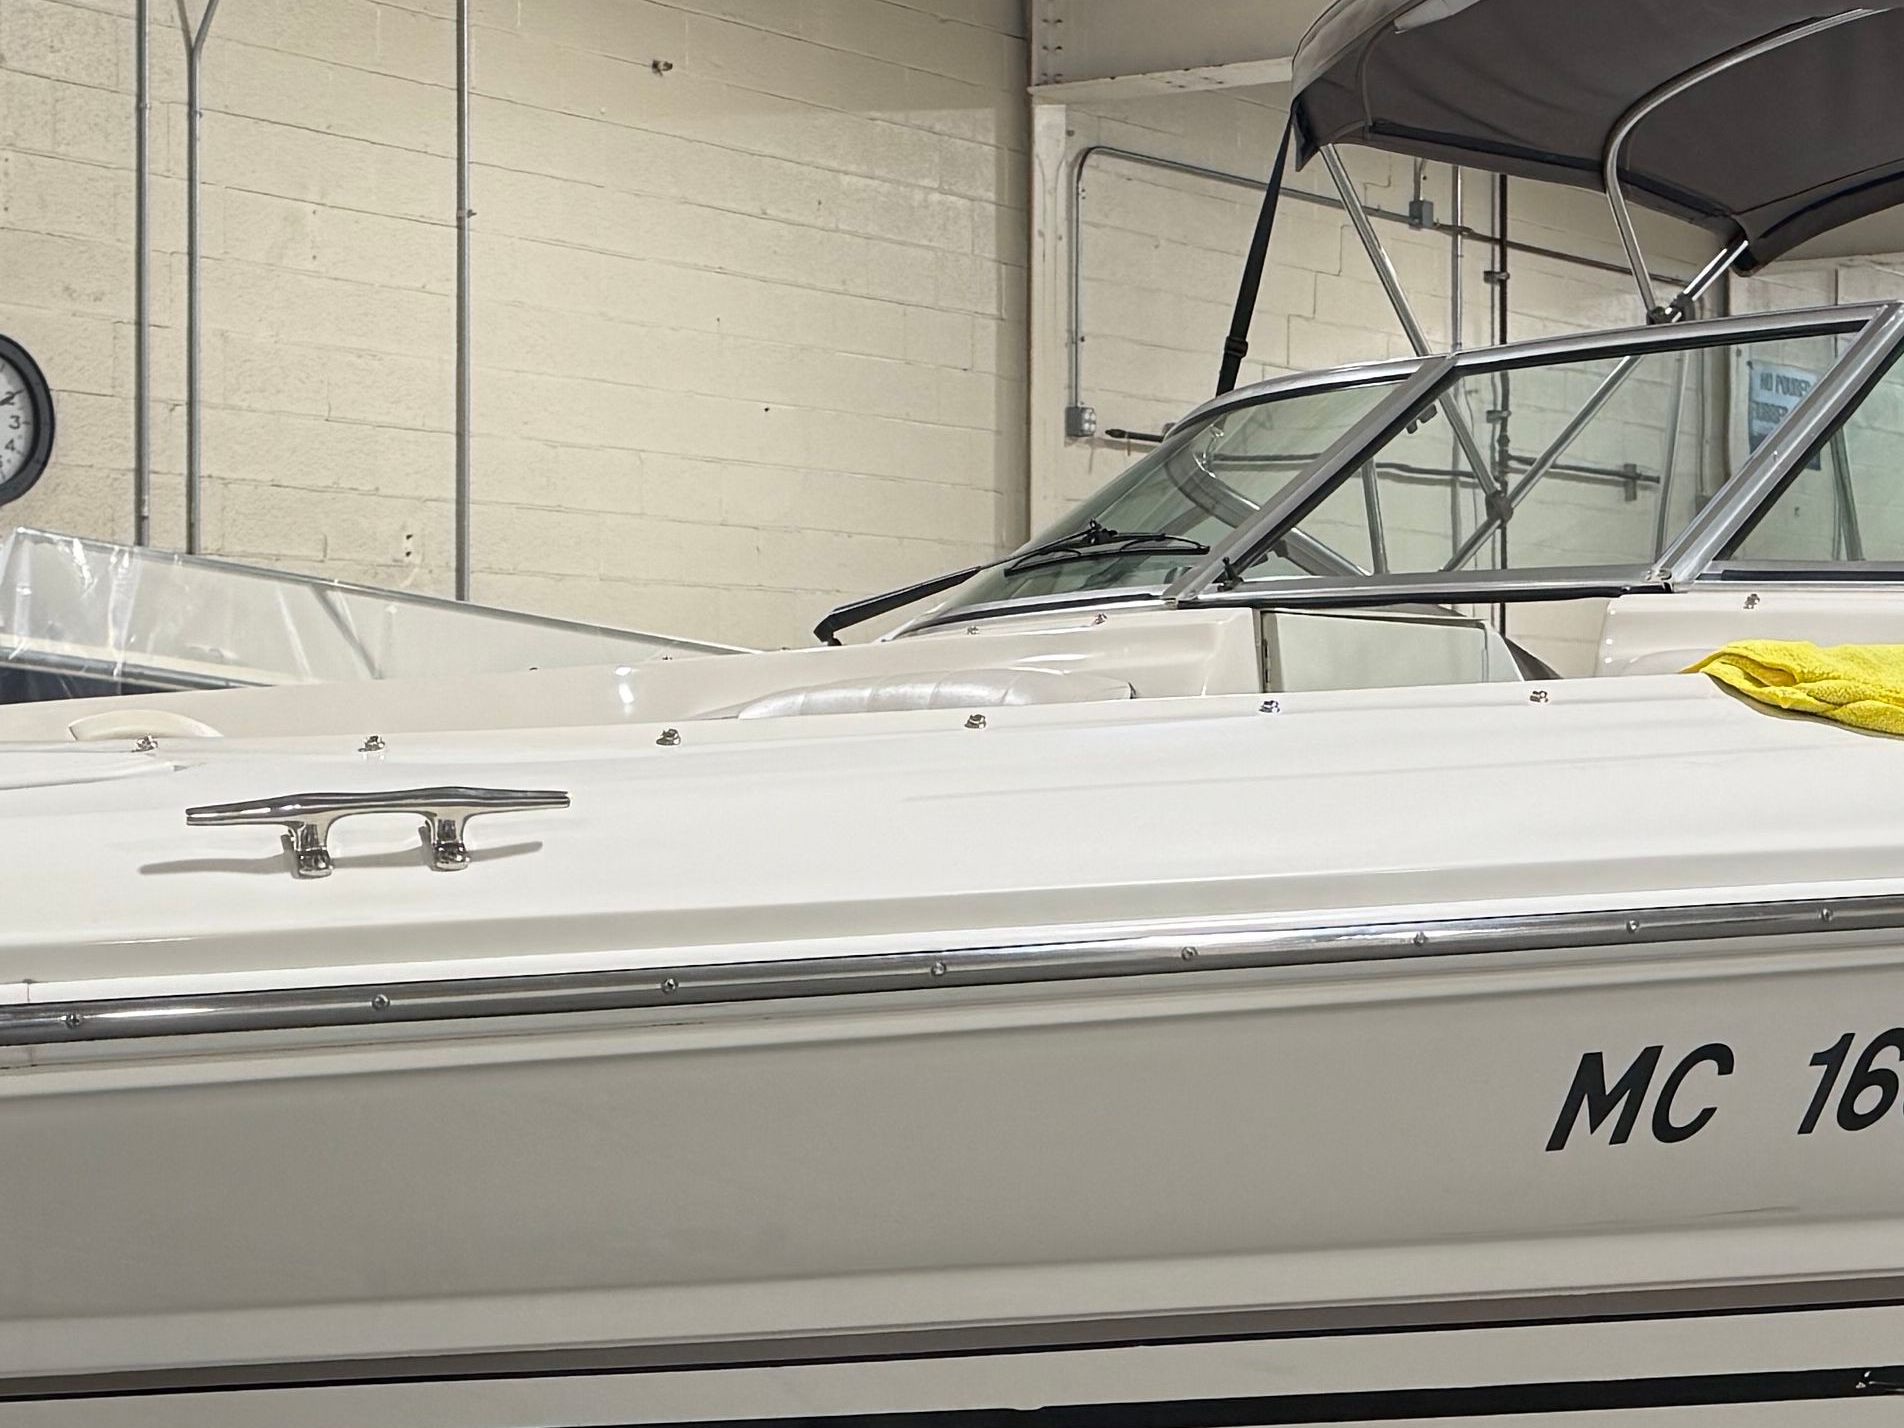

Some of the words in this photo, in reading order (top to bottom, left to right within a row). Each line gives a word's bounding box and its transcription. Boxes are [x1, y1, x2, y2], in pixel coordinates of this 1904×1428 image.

[8, 415, 21, 430] 3
[4, 438, 16, 452] 4
[1546, 1043, 1734, 1151] MC
